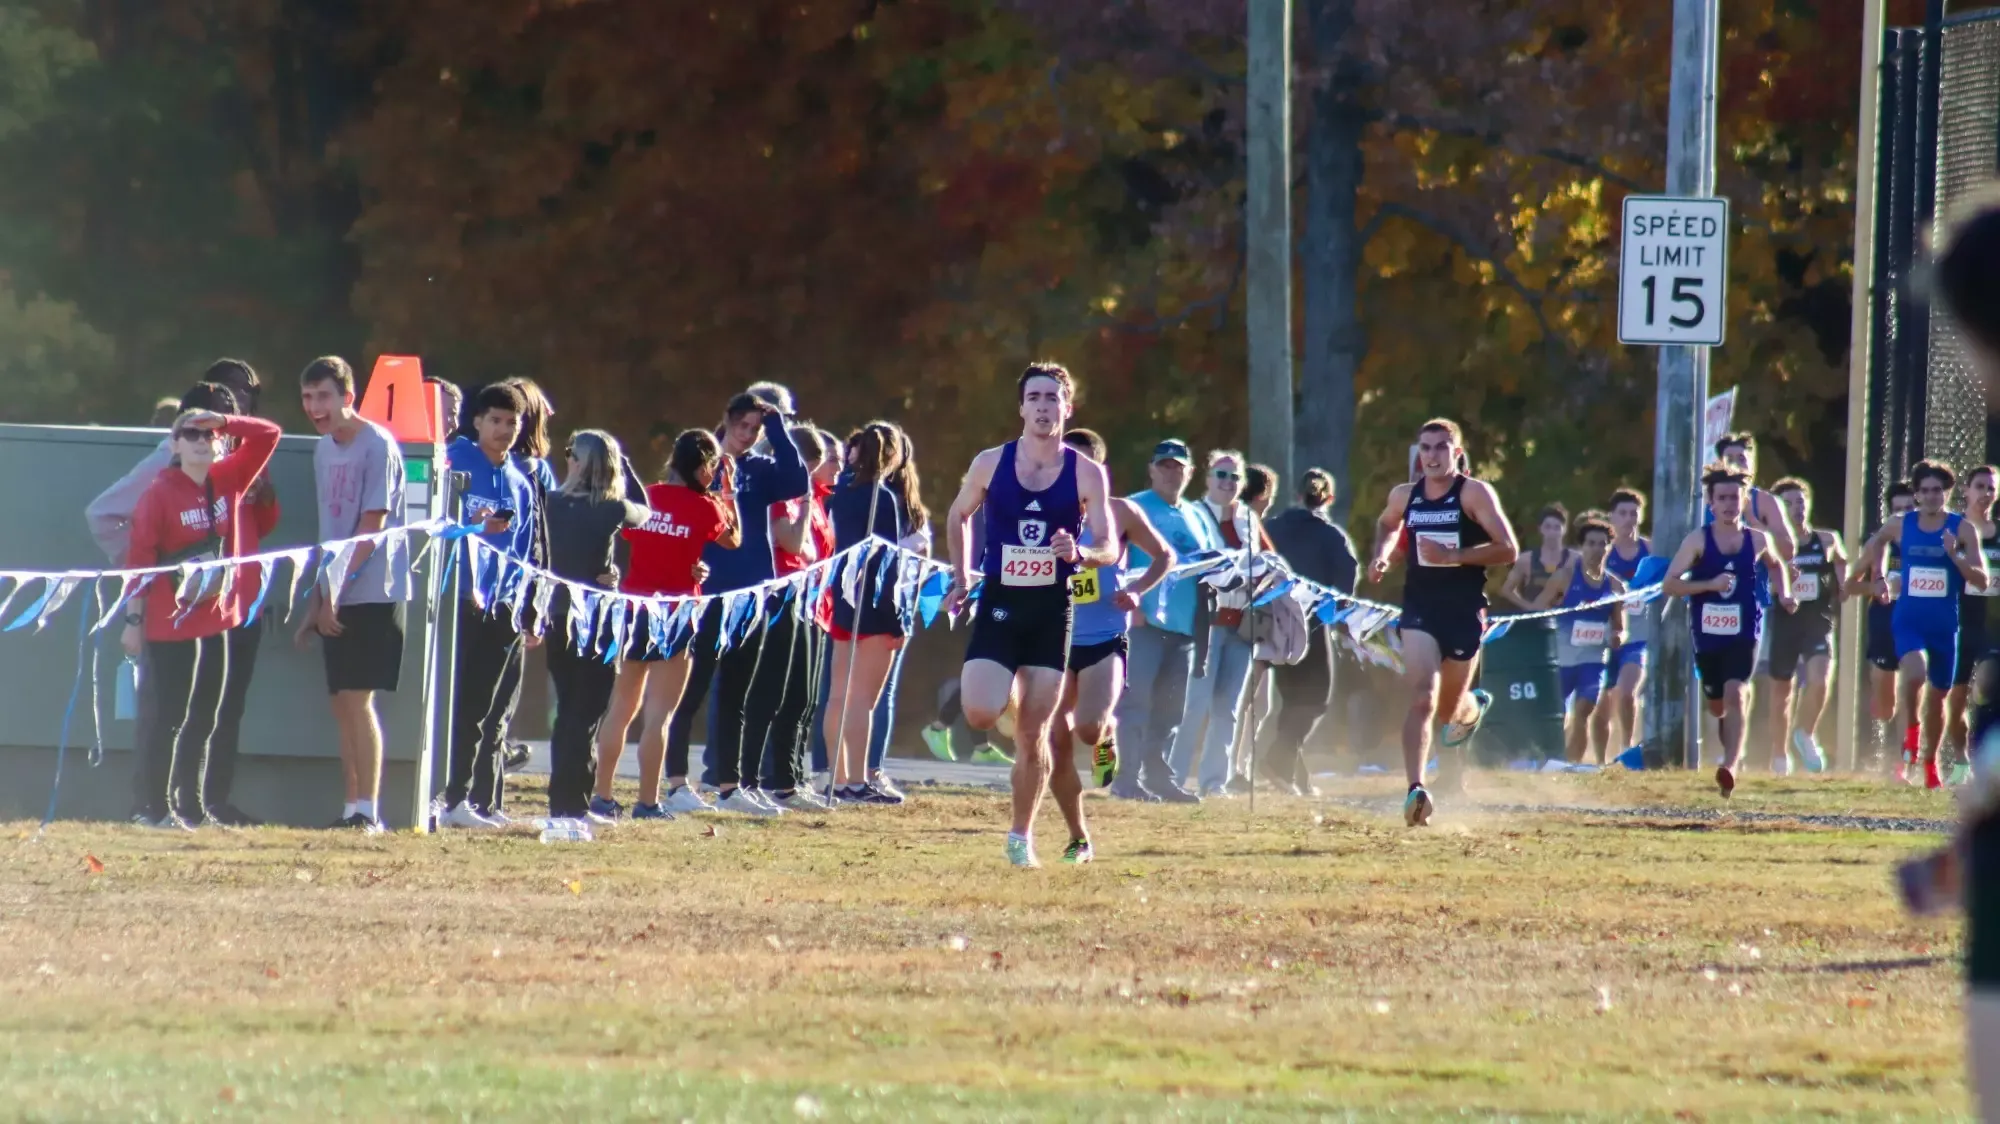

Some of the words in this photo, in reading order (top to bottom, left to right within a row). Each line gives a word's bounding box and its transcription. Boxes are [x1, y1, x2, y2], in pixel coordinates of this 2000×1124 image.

[1632, 215, 1717, 238] SPEED
[1640, 245, 1705, 267] LIMIT
[1641, 275, 1705, 329] 15
[386, 383, 395, 422] 1
[1406, 509, 1460, 527] PROVIDENCE
[1003, 560, 1054, 577] 4293
[1910, 577, 1945, 591] 4220
[1703, 614, 1738, 628] 4298
